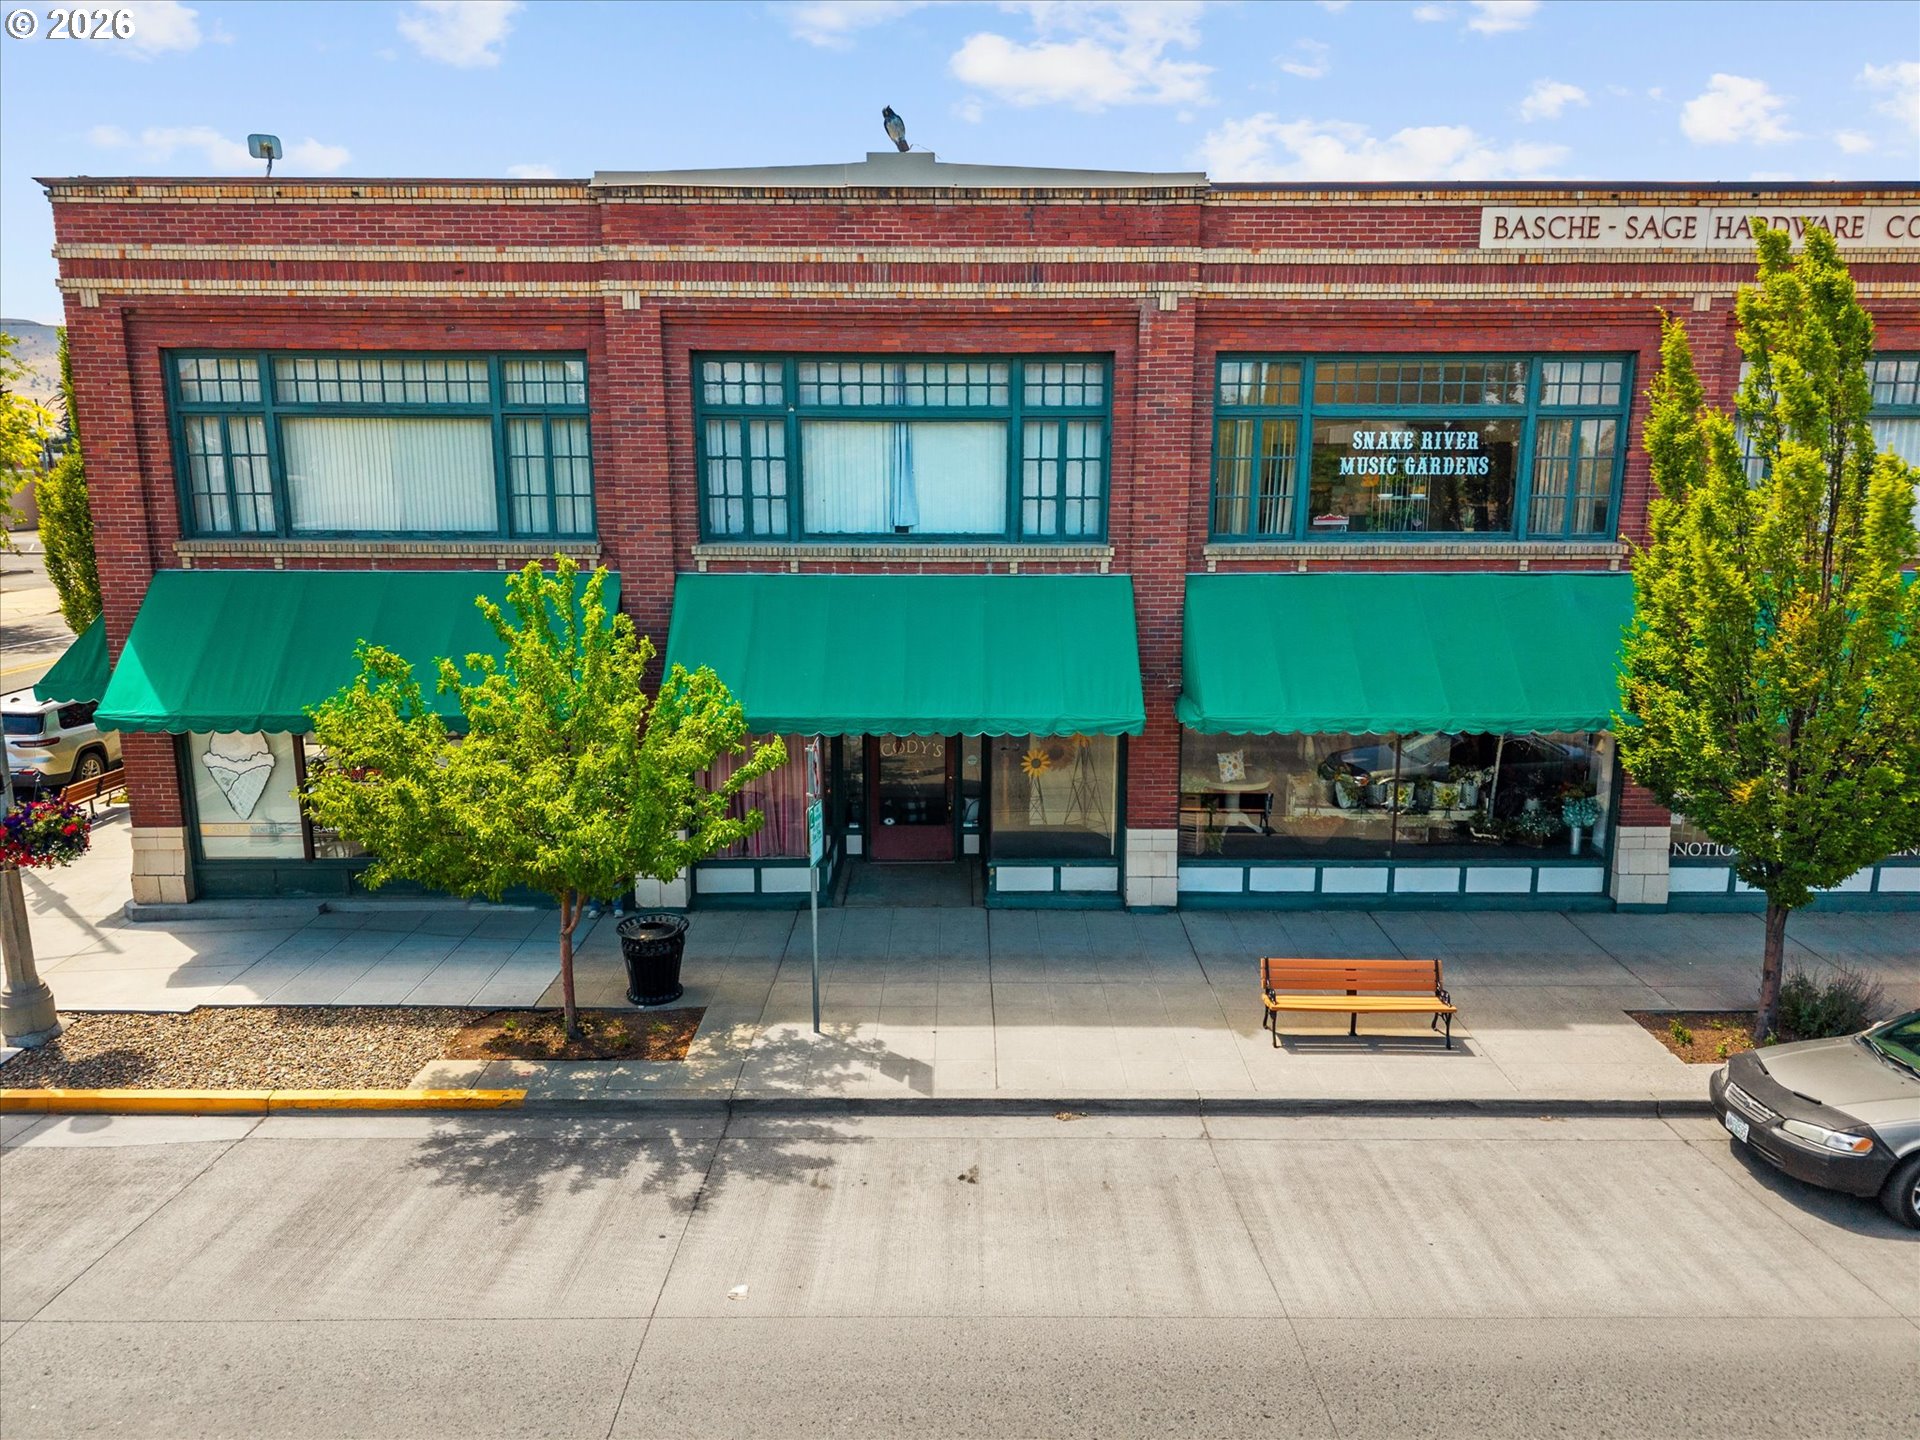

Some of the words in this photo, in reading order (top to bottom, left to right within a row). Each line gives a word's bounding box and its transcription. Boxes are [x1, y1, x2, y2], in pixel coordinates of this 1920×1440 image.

[1493, 215, 1600, 240] BASCHE
[1625, 215, 1698, 240] SAGE
[1715, 215, 1865, 240] HADWARE
[1352, 431, 1414, 450] SNAKE
[1420, 431, 1479, 450] RIVER
[1339, 456, 1397, 475] MUSIC
[1404, 456, 1490, 476] GARDENS
[881, 739, 944, 758] CODY'S
